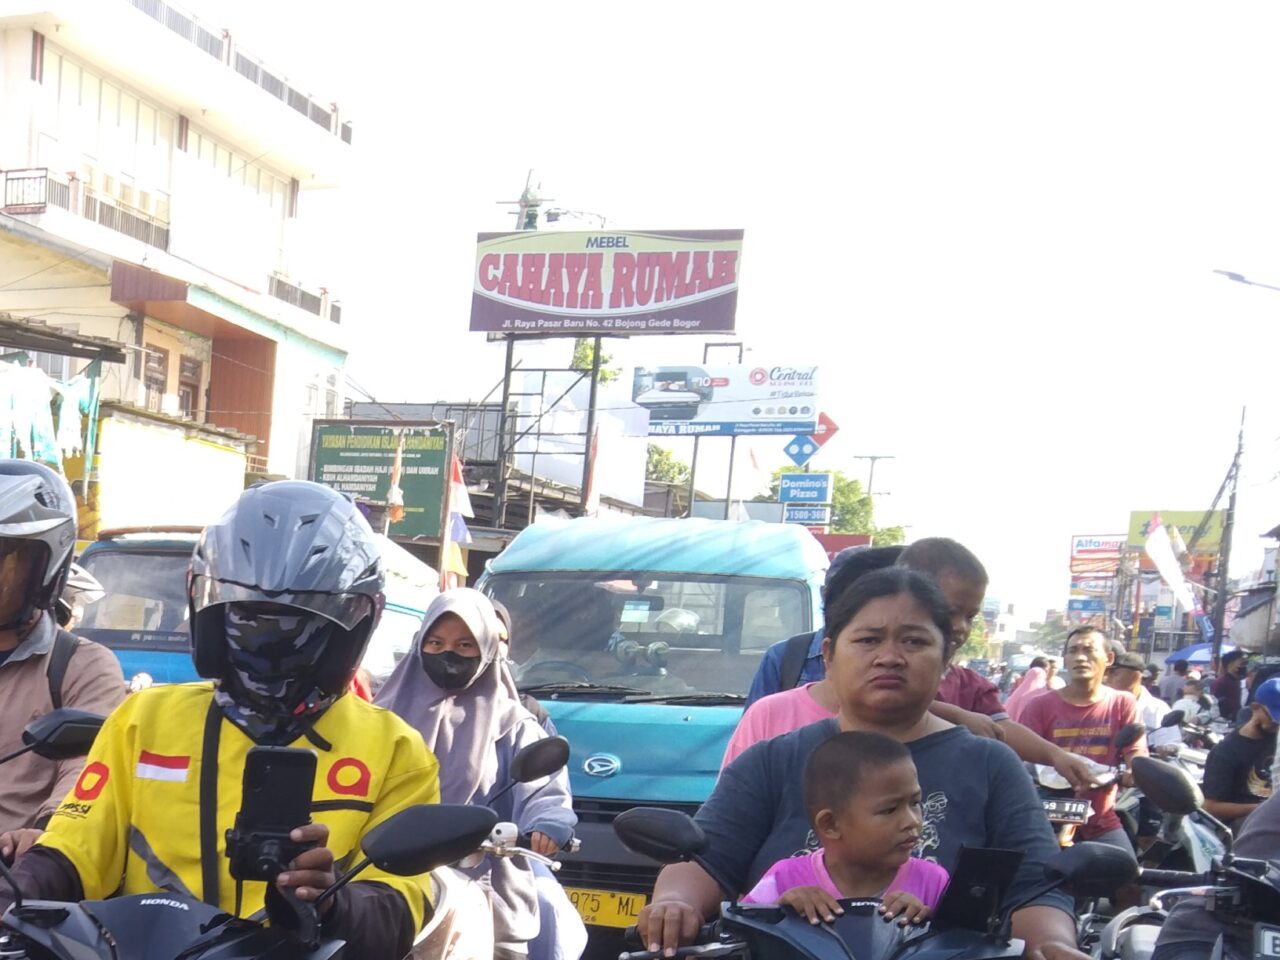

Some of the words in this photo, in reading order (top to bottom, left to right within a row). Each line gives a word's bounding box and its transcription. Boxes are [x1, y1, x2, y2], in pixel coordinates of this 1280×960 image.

[586, 237, 629, 248] MEBEL
[479, 252, 603, 309] CAHAYA
[609, 251, 738, 309] RUMAH
[502, 320, 512, 328] Jl.
[515, 320, 536, 328] Raya
[615, 319, 646, 329] Bojong
[648, 319, 671, 327] Gede
[673, 319, 701, 328] Bogor
[770, 366, 818, 380] Central
[782, 479, 826, 488] Domino's
[790, 489, 817, 498] Pizza
[140, 898, 189, 911] HONDA
